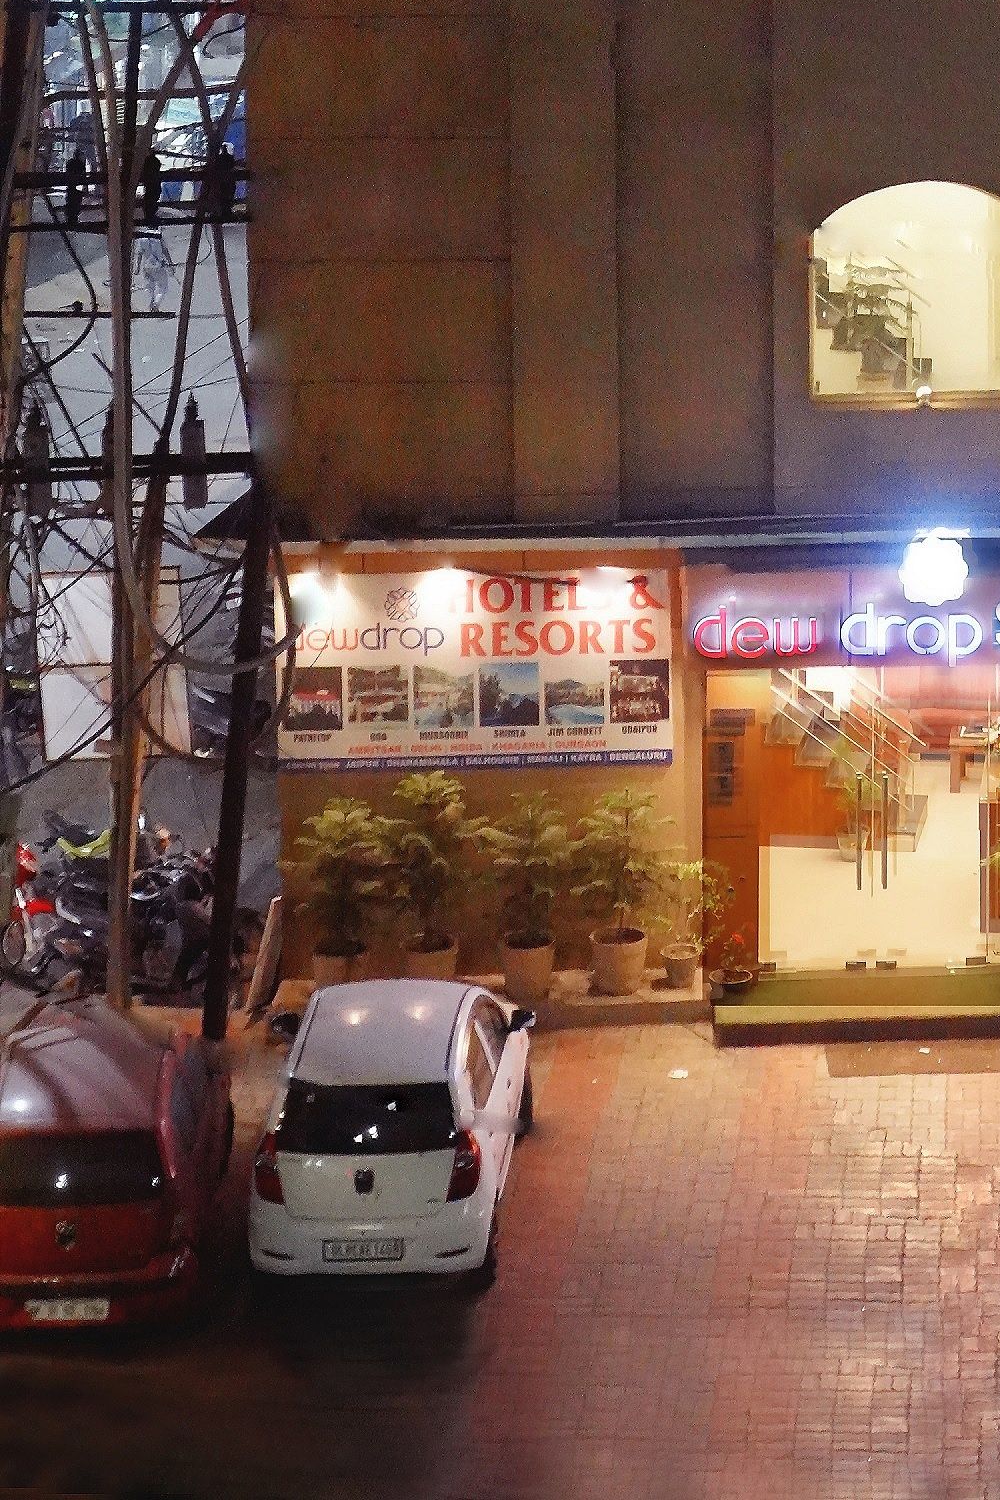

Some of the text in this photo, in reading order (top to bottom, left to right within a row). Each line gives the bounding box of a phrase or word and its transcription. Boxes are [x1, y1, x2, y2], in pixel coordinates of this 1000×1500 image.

[459, 618, 657, 658] RESORTS
[693, 602, 820, 658] dew
[841, 603, 983, 667] drop
